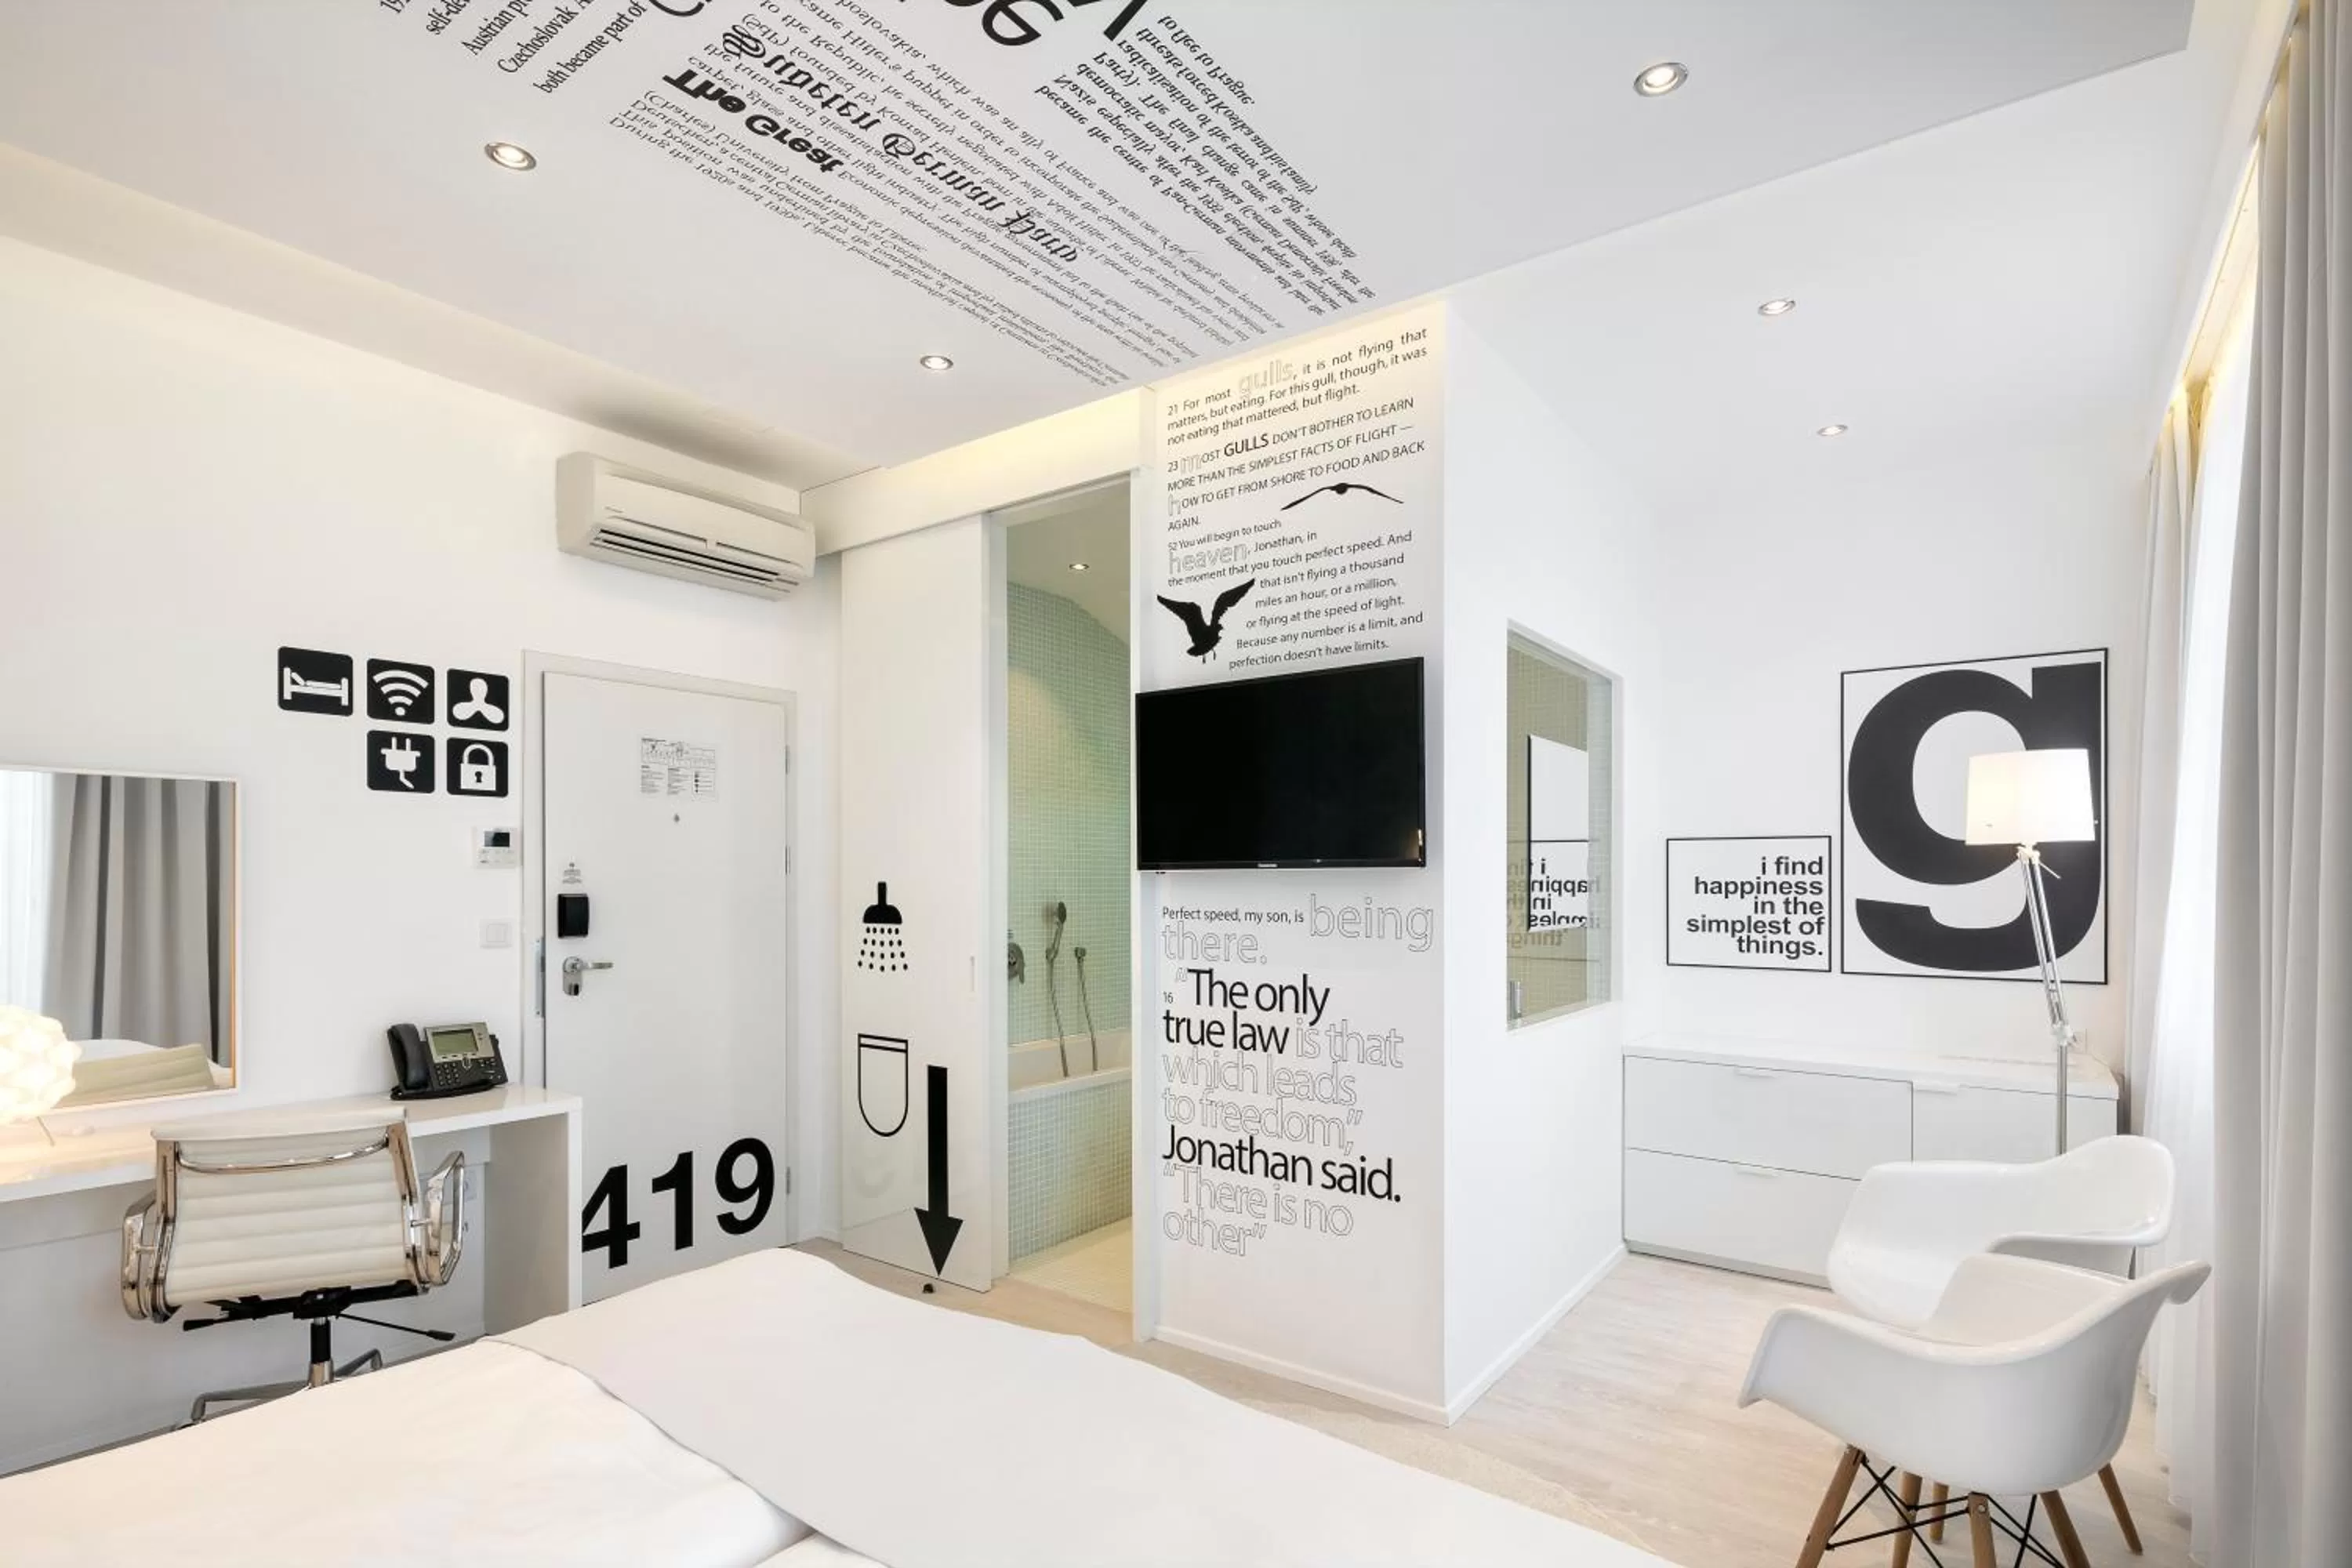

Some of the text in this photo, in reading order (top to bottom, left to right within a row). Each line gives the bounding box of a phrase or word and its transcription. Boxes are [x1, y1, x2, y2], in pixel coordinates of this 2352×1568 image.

[461, 8, 516, 56] Austrian
[497, 6, 579, 74] Czechoslovak
[532, 1, 648, 93] both became part of
[1167, 404, 1178, 416] 21
[1183, 399, 1200, 411] For
[1205, 388, 1230, 404] most
[1302, 363, 1311, 374] it
[1316, 360, 1326, 370] is
[1332, 350, 1352, 365] not
[1359, 339, 1393, 358] flying
[1400, 328, 1426, 344] that
[1167, 413, 1207, 430] matters,
[1210, 405, 1228, 417] but
[1269, 389, 1287, 401] For
[1289, 382, 1309, 394] this
[1312, 372, 1336, 390] gull,
[1339, 358, 1388, 380] though,
[1390, 354, 1398, 365] it
[1401, 347, 1427, 361] was
[1167, 383, 1359, 445] not eating that mattered, but flight.
[1167, 460, 1178, 472] 23
[1224, 433, 1269, 456] GULLS
[1272, 426, 1306, 445] DON'T
[1308, 413, 1353, 434] BOTHER
[1356, 408, 1372, 421] TO
[1374, 397, 1414, 417] LEARN
[1167, 424, 1396, 491] MORE THAN THE SIMPLEST FACTS OF FLIGHT
[1200, 492, 1214, 503] TO
[1216, 486, 1235, 499] GET
[1238, 478, 1268, 495] FROM
[1269, 469, 1305, 488] SHORE
[1307, 465, 1323, 477] TO
[1326, 456, 1359, 474] FOOD
[1362, 449, 1389, 465] AND
[1392, 440, 1425, 458] BACK
[1167, 515, 1201, 531] AGAIN.
[1254, 535, 1303, 552] Jonathan,
[1307, 531, 1316, 541] in
[1167, 529, 1411, 586] the moment that you touch perfect speed. And
[1260, 552, 1403, 588] that isn't flying a thousand
[1246, 595, 1403, 629] or flying at the speed of light.
[1255, 596, 1282, 608] miles
[1284, 593, 1297, 603] an
[1300, 589, 1327, 601] hour,
[1330, 586, 1342, 596] or
[1354, 578, 1396, 591] million,
[1229, 639, 1388, 670] perfection doesn't have limits.
[1236, 611, 1423, 649] Because any number is a limit, and
[1848, 662, 2101, 971] g
[1694, 876, 1823, 898] happiness
[1762, 856, 1823, 875] i find
[1163, 893, 1434, 952] Perfect speed, my son, is being
[1686, 914, 1825, 938] simplest of
[1754, 896, 1824, 915] in the
[1162, 920, 1268, 964] there.
[1737, 935, 1823, 960] things.
[1163, 992, 1174, 1004] 16
[1255, 973, 1330, 1026] only
[1163, 1010, 1404, 1069] true law is that
[1163, 1046, 1357, 1105] which leads
[1164, 1088, 1196, 1124] to
[1163, 1124, 1401, 1203] Jonathan said.
[582, 1137, 775, 1269] 419
[1274, 1183, 1298, 1225] is
[1305, 1200, 1353, 1236] no
